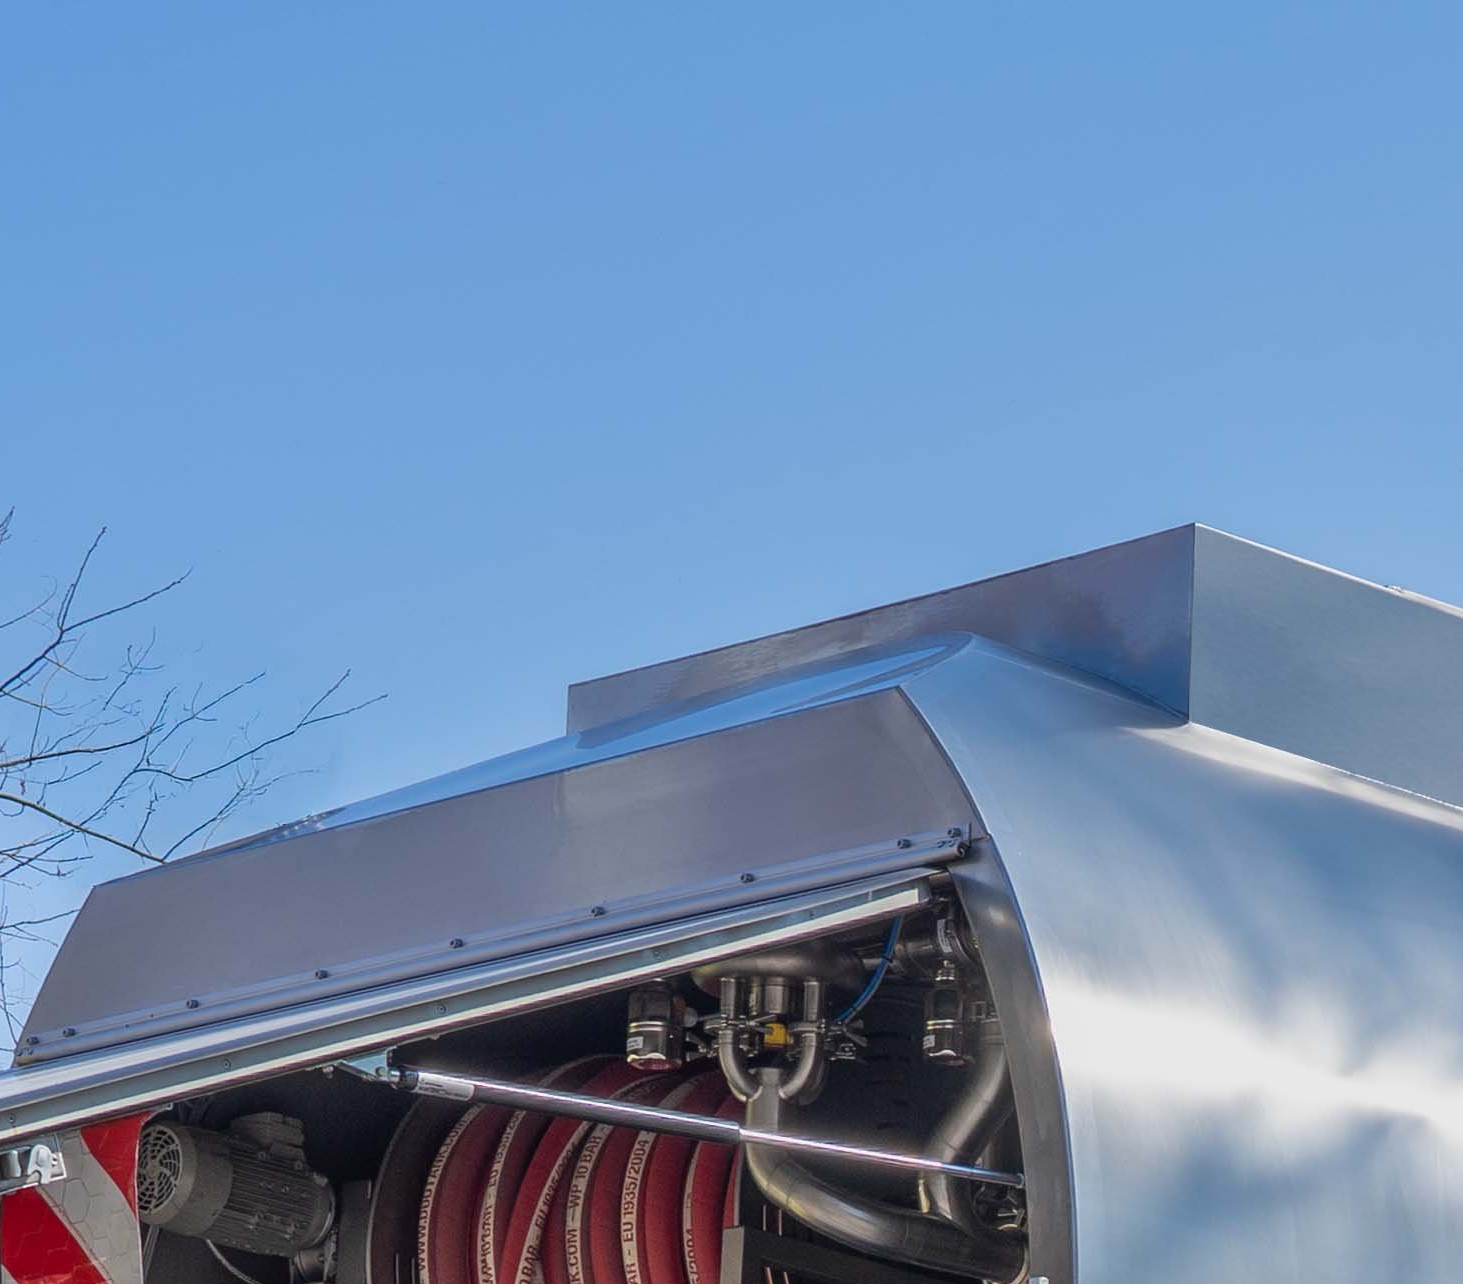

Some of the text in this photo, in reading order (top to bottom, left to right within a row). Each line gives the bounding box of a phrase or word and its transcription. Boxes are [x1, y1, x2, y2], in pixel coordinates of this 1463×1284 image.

[579, 1135, 603, 1162] BAR
[574, 1161, 588, 1183] 10
[623, 1138, 650, 1218] 1935/2004
[568, 1183, 583, 1210] WP
[623, 1220, 635, 1242] EU
[521, 1244, 540, 1278] BAR
